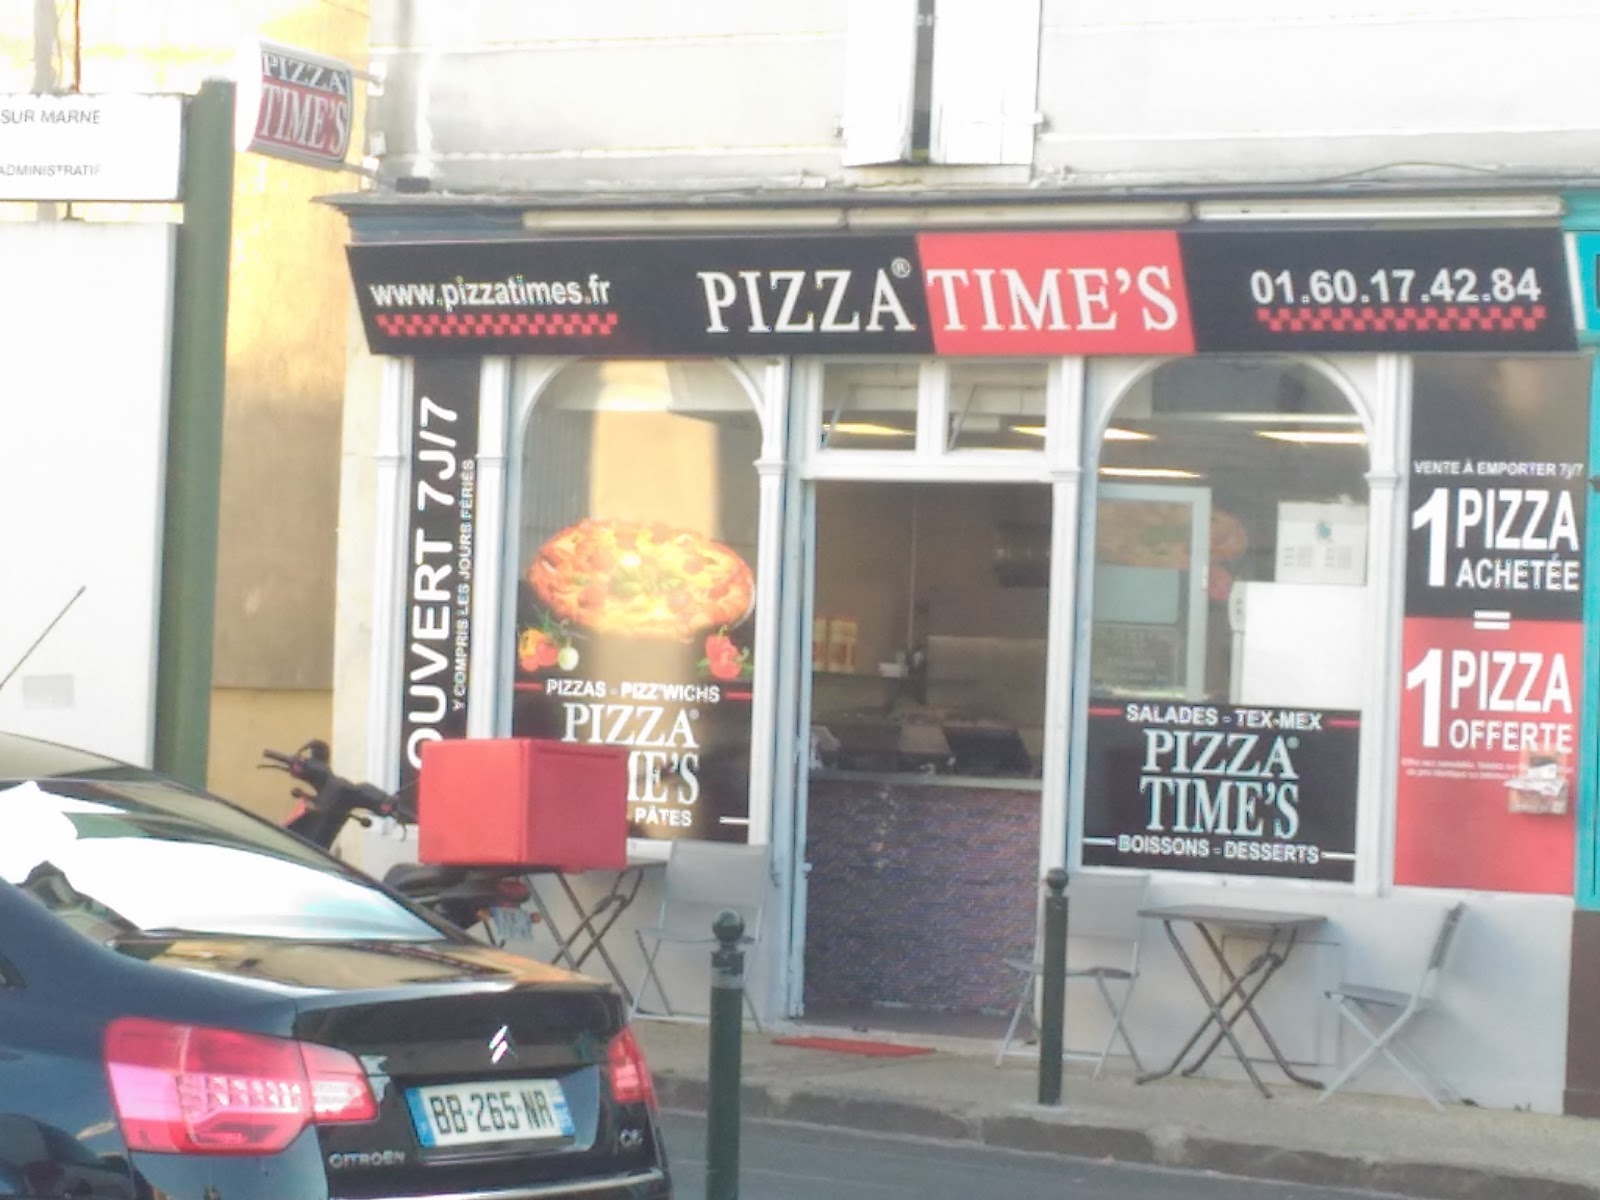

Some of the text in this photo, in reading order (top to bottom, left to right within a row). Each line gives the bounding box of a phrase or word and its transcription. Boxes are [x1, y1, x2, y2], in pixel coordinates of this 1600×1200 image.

[262, 53, 347, 95] PIZZA
[1, 109, 100, 124] SUR MARNE
[258, 84, 347, 156] TIME'S
[369, 274, 611, 312] www.pizzatimes.fr
[926, 265, 1179, 332] TIME'S
[1250, 268, 1541, 304] 01.60.17.42.84
[1414, 460, 1460, 475] VENTE
[1477, 461, 1556, 477] EMPORTER
[458, 522, 473, 580] JOURS
[1412, 488, 1579, 588] 1 PIZZA
[407, 396, 458, 770] OUVERT 7J/7
[1455, 552, 1580, 591] ACHETÉE
[457, 583, 471, 616] LES
[453, 619, 469, 696] COMPRIS
[546, 678, 607, 698] PIZZAS
[620, 681, 721, 703] PIZZ'WICHS
[1406, 648, 1573, 748] 1 PIZZA
[1126, 703, 1218, 725] SALADES
[1234, 709, 1323, 731] TEX-MEX
[1449, 718, 1573, 754] OFFERTE
[634, 805, 693, 827] PÂTES
[1139, 776, 1299, 840] TIME'S
[1117, 834, 1209, 858] BOISSONS
[1224, 840, 1320, 864] DESSERTS
